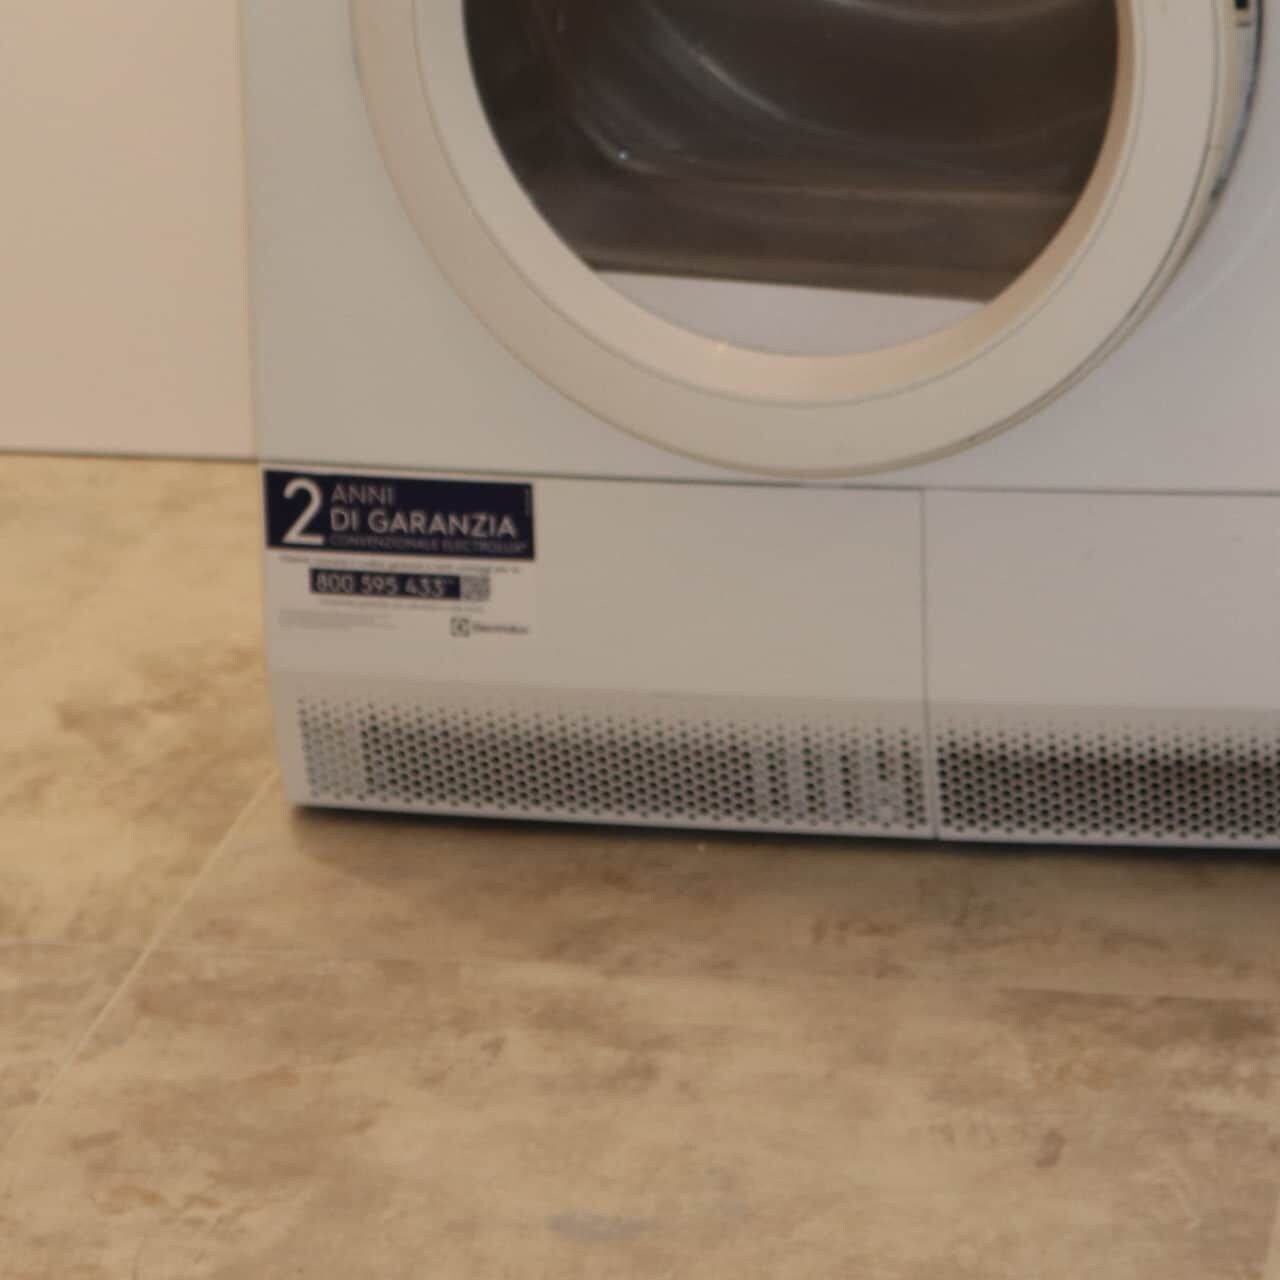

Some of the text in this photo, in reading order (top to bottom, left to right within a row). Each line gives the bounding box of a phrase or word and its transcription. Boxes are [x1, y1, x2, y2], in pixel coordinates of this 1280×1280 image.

[330, 483, 395, 505] ANNI
[281, 477, 325, 545] 2
[330, 508, 518, 538] DI GARANZIA
[315, 573, 354, 593] 800
[360, 575, 398, 596] 595
